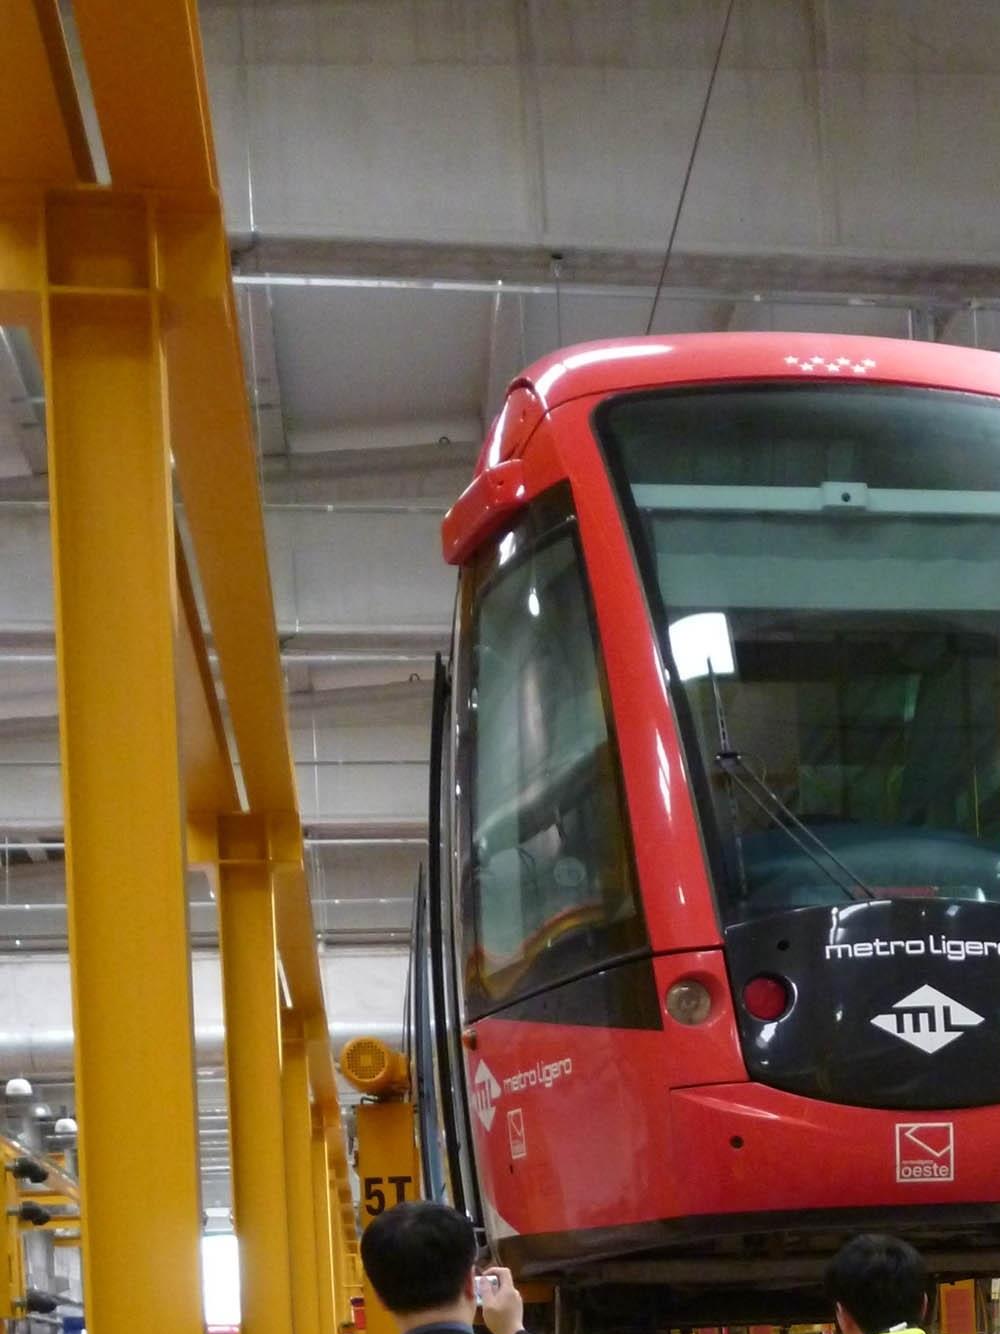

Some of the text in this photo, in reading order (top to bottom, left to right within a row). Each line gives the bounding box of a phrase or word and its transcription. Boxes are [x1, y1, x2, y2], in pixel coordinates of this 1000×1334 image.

[825, 938, 926, 959] metro
[901, 1163, 949, 1177] oeste
[364, 1176, 412, 1216] 5T
